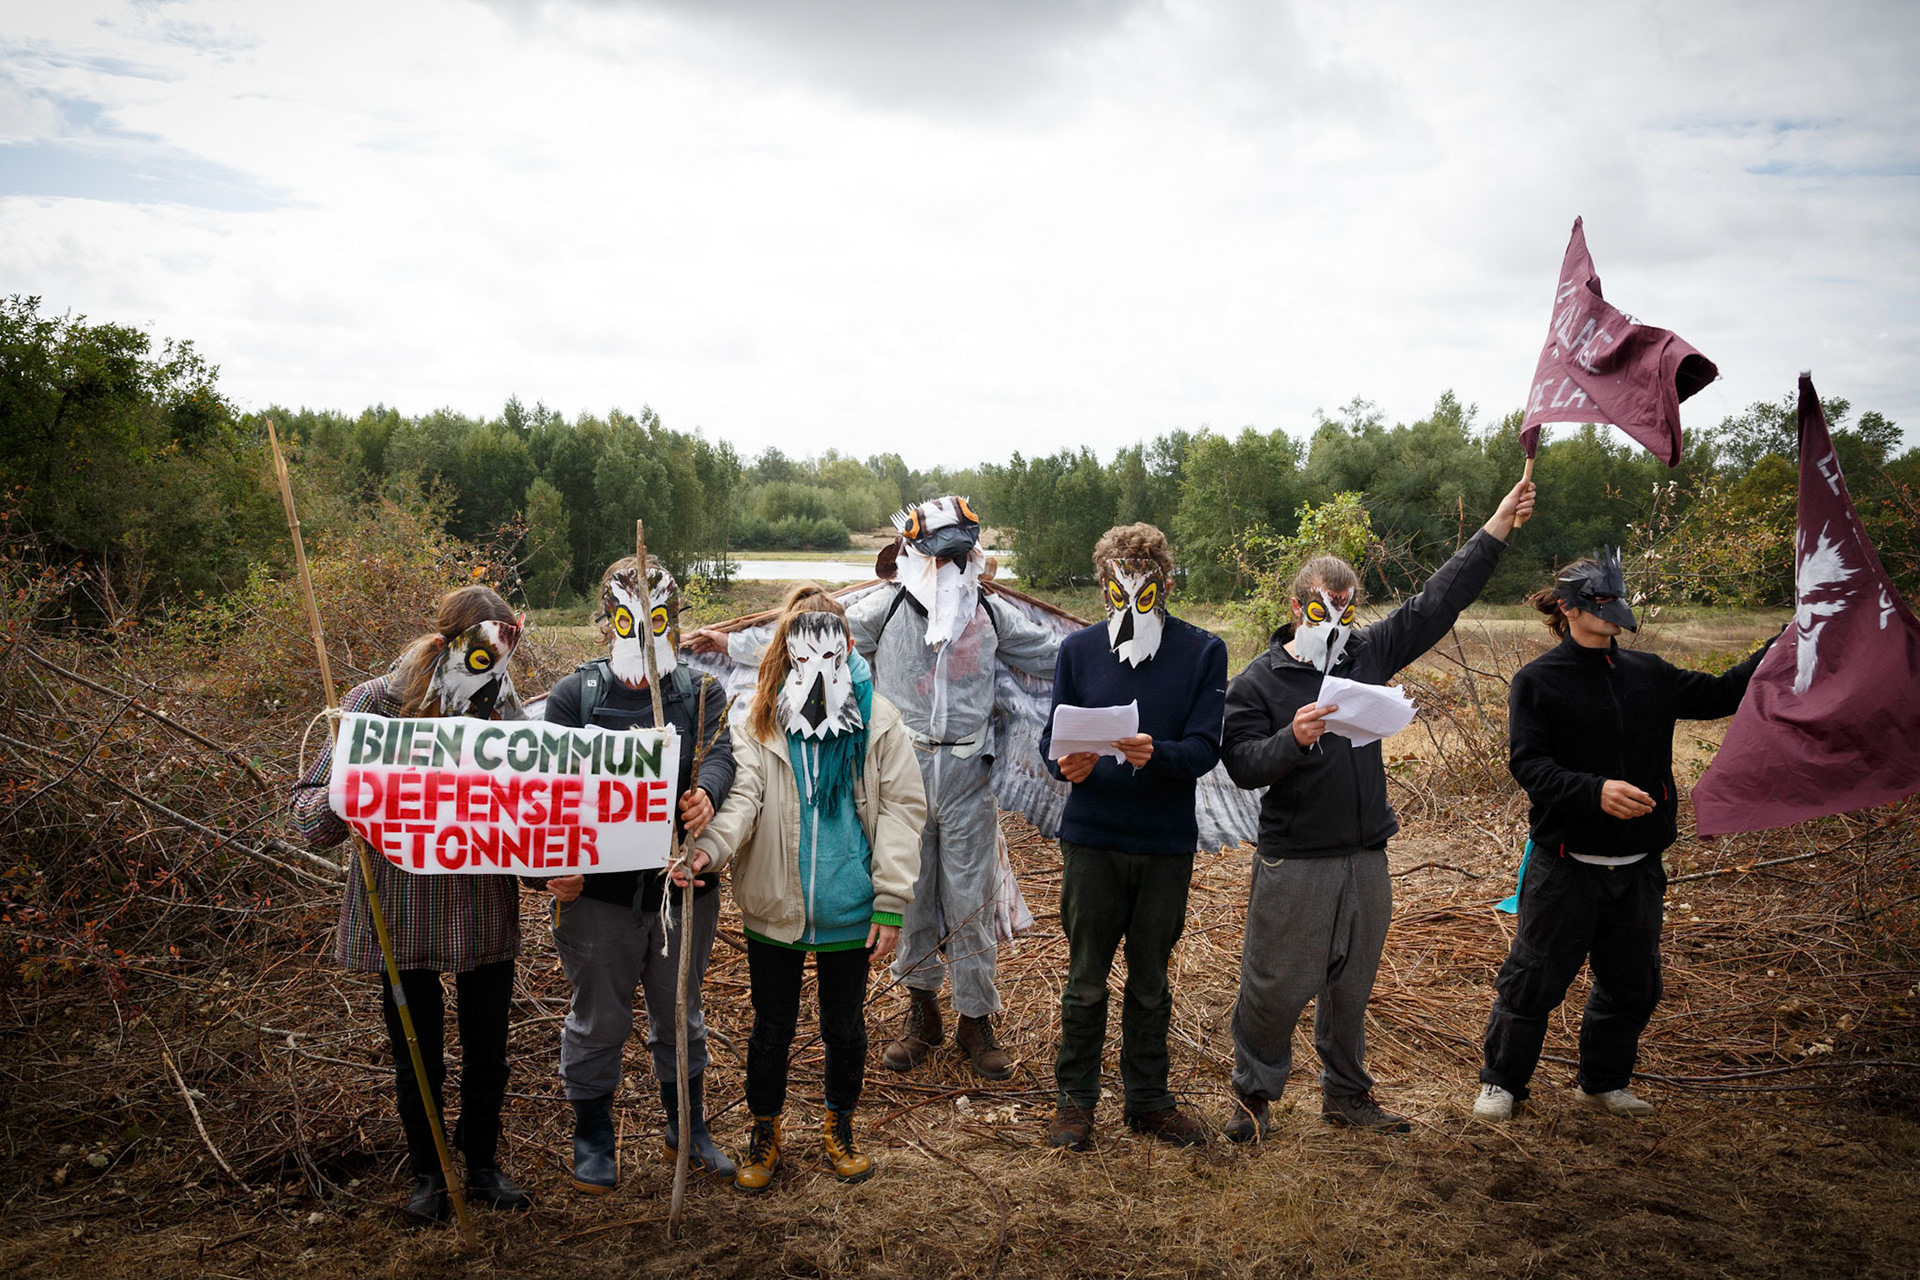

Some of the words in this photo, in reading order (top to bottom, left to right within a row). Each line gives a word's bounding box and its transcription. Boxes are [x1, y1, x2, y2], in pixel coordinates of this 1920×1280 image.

[349, 718, 465, 768] BIEN
[474, 727, 665, 779] COMMUN
[346, 767, 581, 825] DÉFENSE
[598, 780, 668, 824] DE
